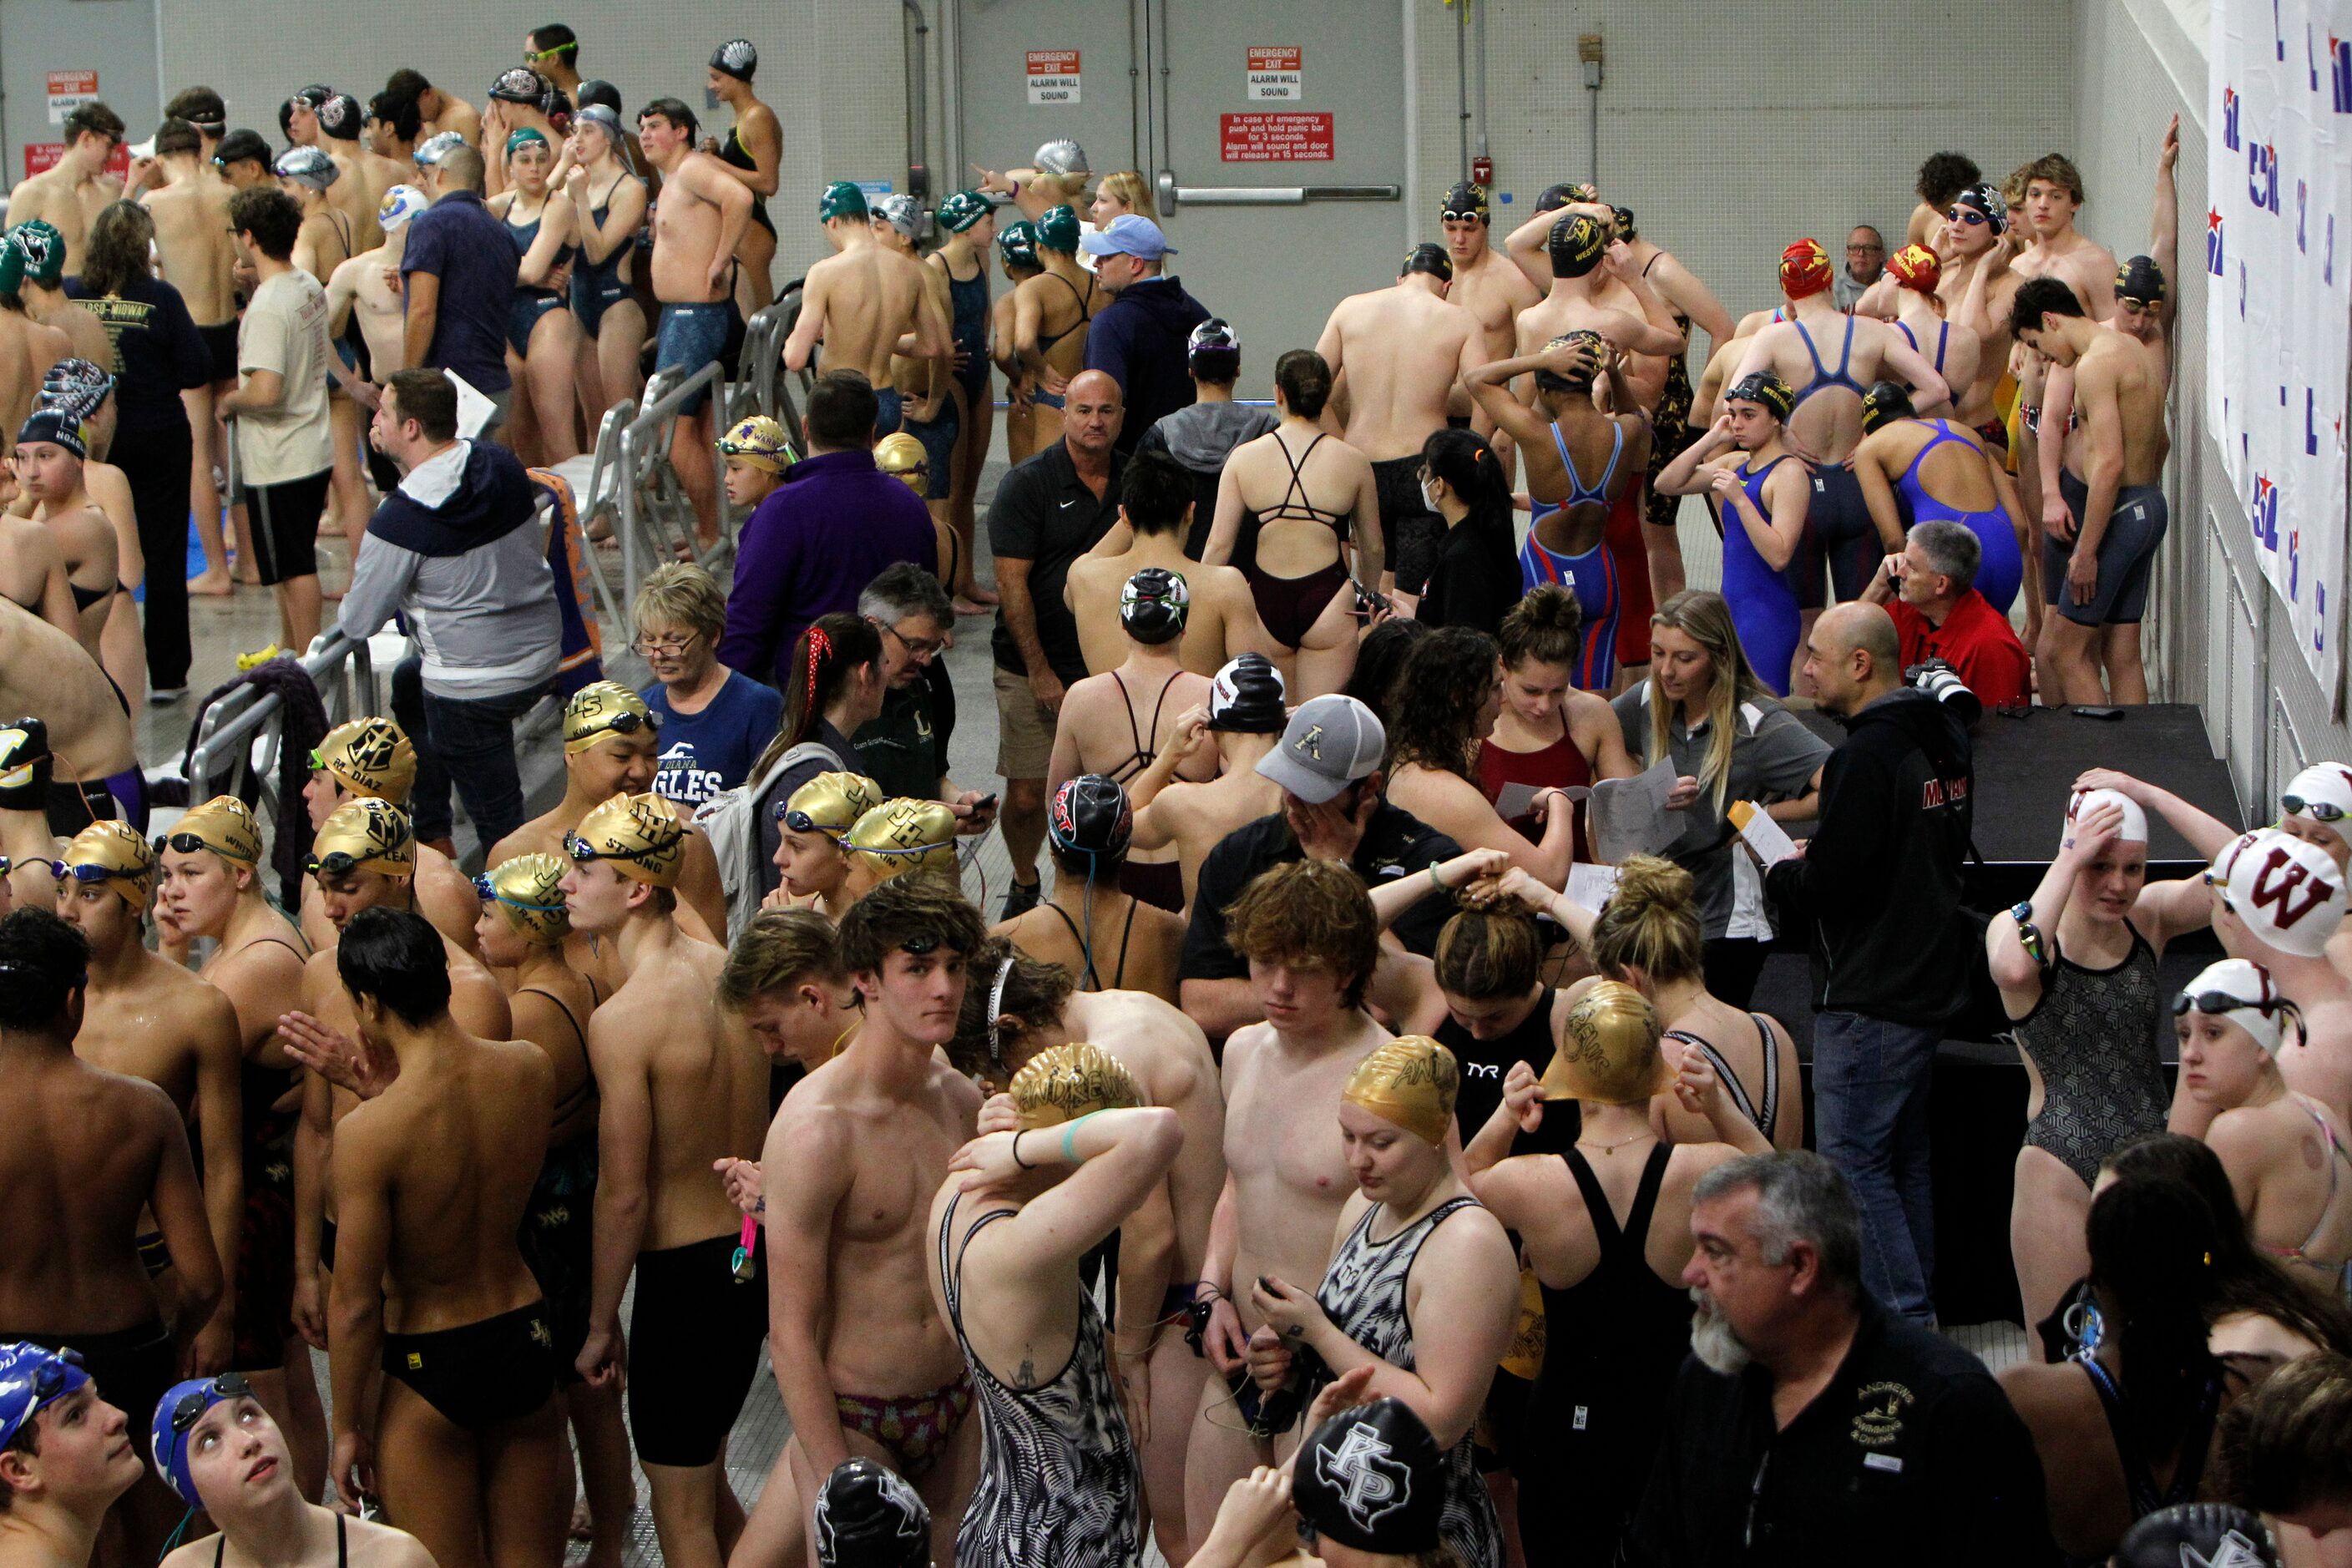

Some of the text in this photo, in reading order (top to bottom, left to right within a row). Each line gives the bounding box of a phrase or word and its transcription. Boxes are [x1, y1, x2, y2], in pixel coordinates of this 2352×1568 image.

[1029, 52, 1075, 62] EMERGENCY
[1249, 48, 1297, 58] EMERGENCY
[1044, 63, 1061, 73] EXIT
[1265, 59, 1282, 68] EXIT
[1030, 78, 1057, 87] ALARM
[1041, 91, 1068, 99] SOUND
[1261, 88, 1288, 96] SOUND
[1277, 116, 1319, 124] emergency
[1287, 124, 1308, 133] panic
[573, 725, 593, 738] KIM
[651, 769, 722, 802] GLES
[2251, 847, 2334, 930] W
[1468, 1062, 1499, 1079] TYR
